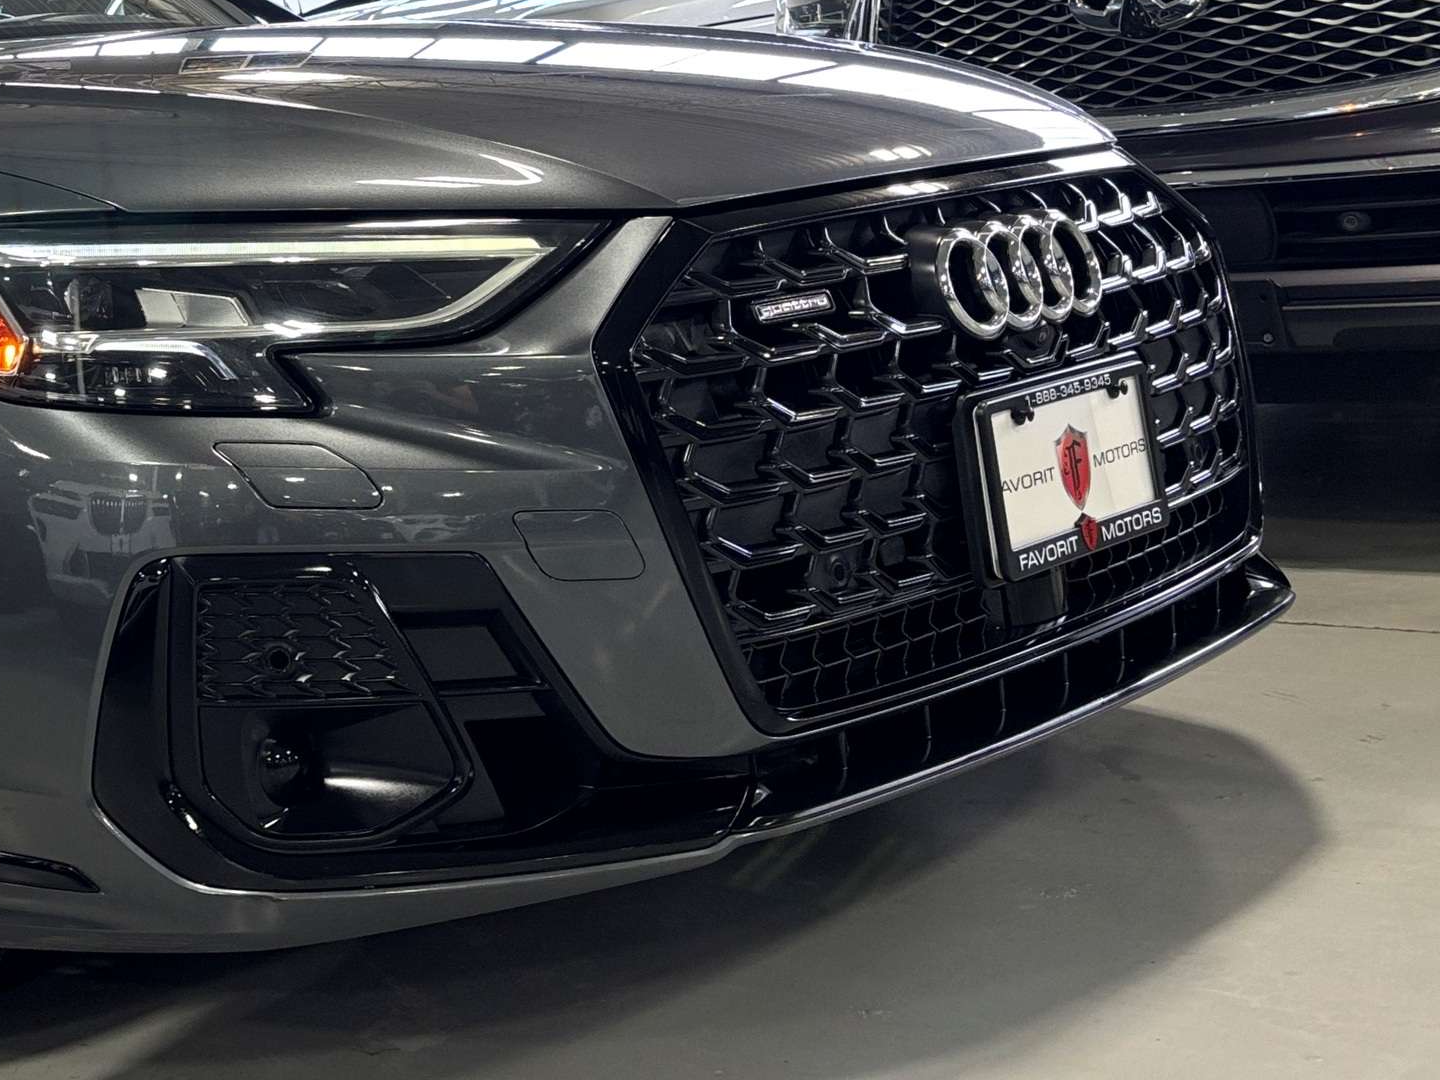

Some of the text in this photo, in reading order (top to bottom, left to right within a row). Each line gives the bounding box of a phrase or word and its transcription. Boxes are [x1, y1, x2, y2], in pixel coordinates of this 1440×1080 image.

[1024, 374, 1111, 407] 1-888-345-9345
[1093, 438, 1147, 468] MOTORS
[1019, 535, 1078, 571] FAVORIT
[1101, 507, 1162, 542] MOTORS
